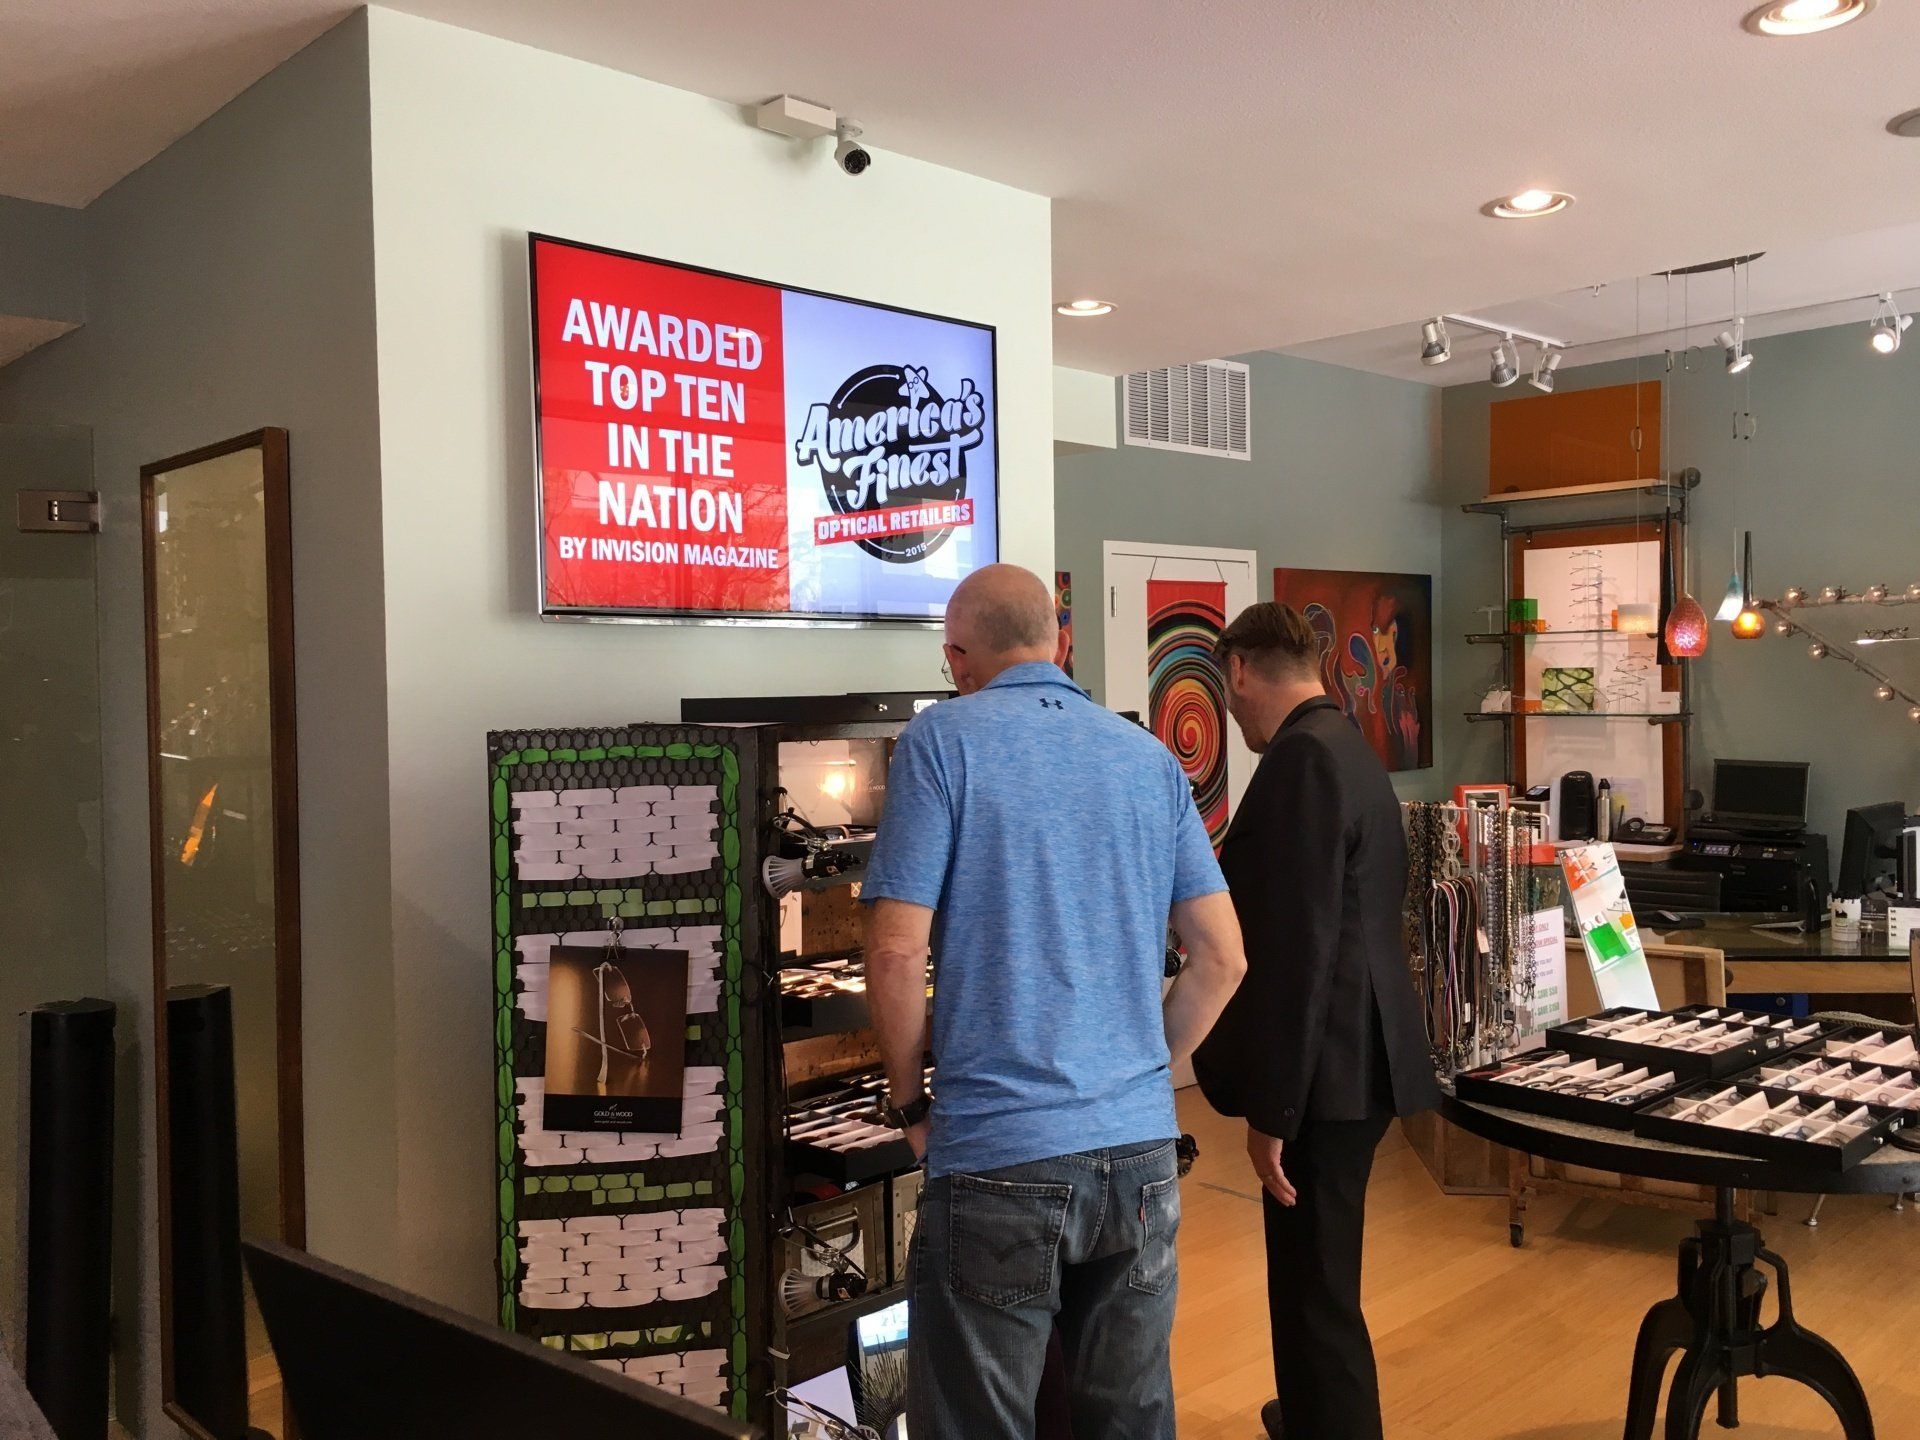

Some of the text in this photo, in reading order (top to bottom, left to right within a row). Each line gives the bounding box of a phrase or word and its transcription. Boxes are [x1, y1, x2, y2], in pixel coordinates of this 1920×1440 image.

[562, 298, 763, 370] AWARDED
[585, 360, 746, 424] TOP TEN
[607, 422, 735, 478] IN THE
[797, 378, 983, 473] America's
[842, 429, 981, 510] Finest
[598, 480, 743, 534] NATION
[817, 503, 970, 540] OPTICAL RETAILERS
[559, 536, 779, 570] BY INVISION MAGAZINE
[905, 543, 927, 557] 2015
